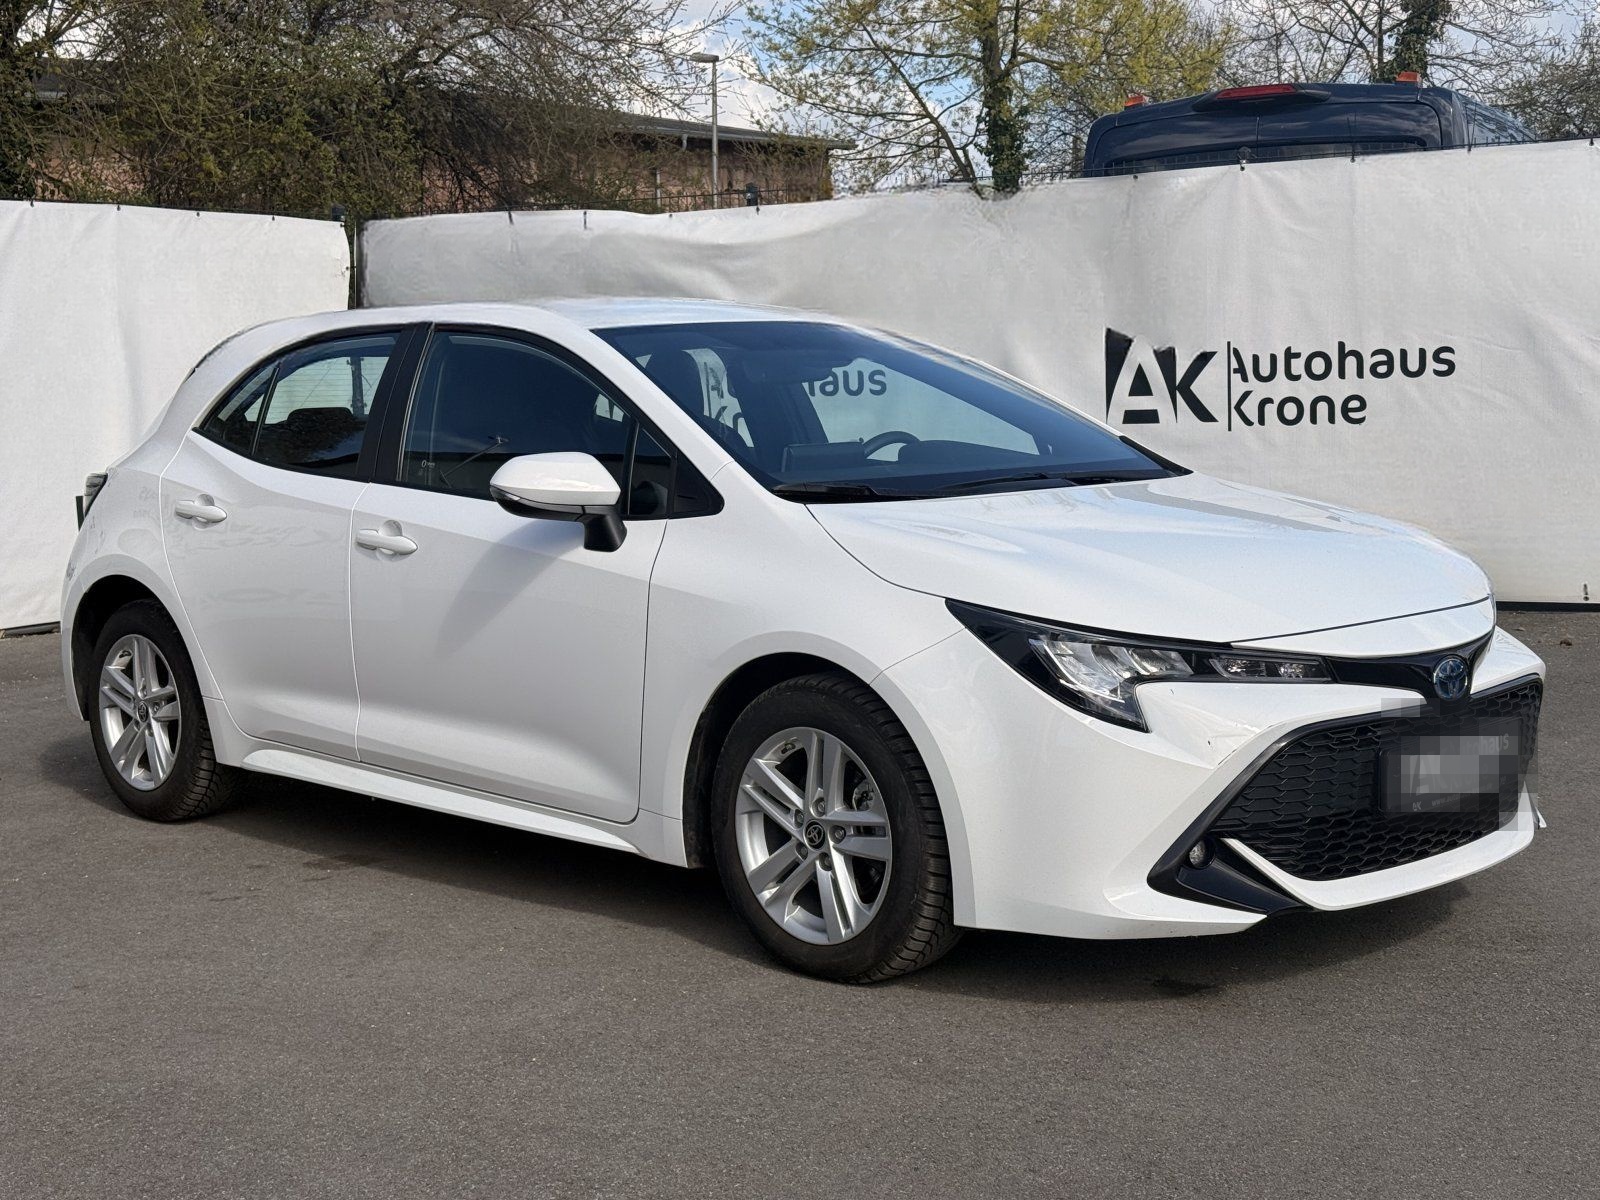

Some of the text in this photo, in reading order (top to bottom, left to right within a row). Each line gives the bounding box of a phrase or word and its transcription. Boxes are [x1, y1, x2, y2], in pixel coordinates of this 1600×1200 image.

[1104, 327, 1219, 424] AK
[1232, 341, 1456, 383] Autohaus
[1233, 390, 1367, 427] Krone
